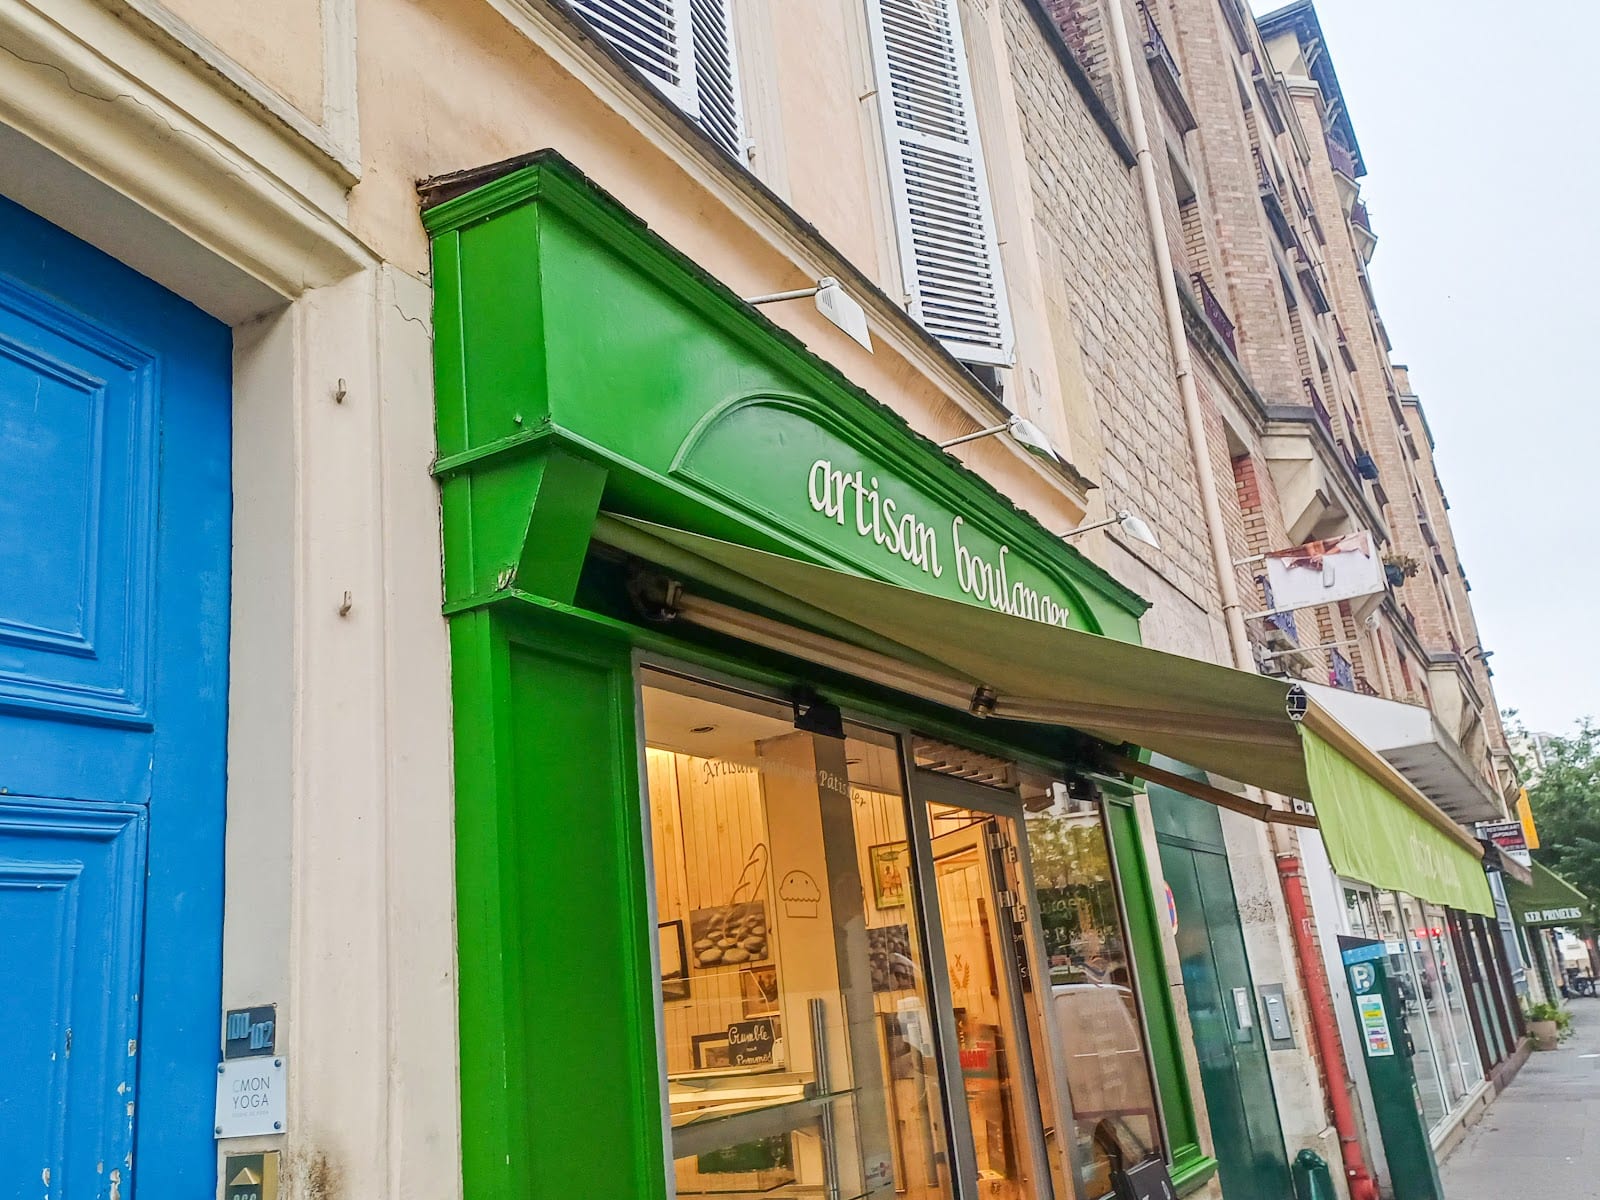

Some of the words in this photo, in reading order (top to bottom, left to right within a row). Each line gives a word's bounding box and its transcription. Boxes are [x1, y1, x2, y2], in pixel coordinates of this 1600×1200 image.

[808, 459, 942, 578] artisan
[728, 1024, 770, 1045] Crumble
[232, 1076, 270, 1093] CMON
[232, 1093, 269, 1110] YOGA
